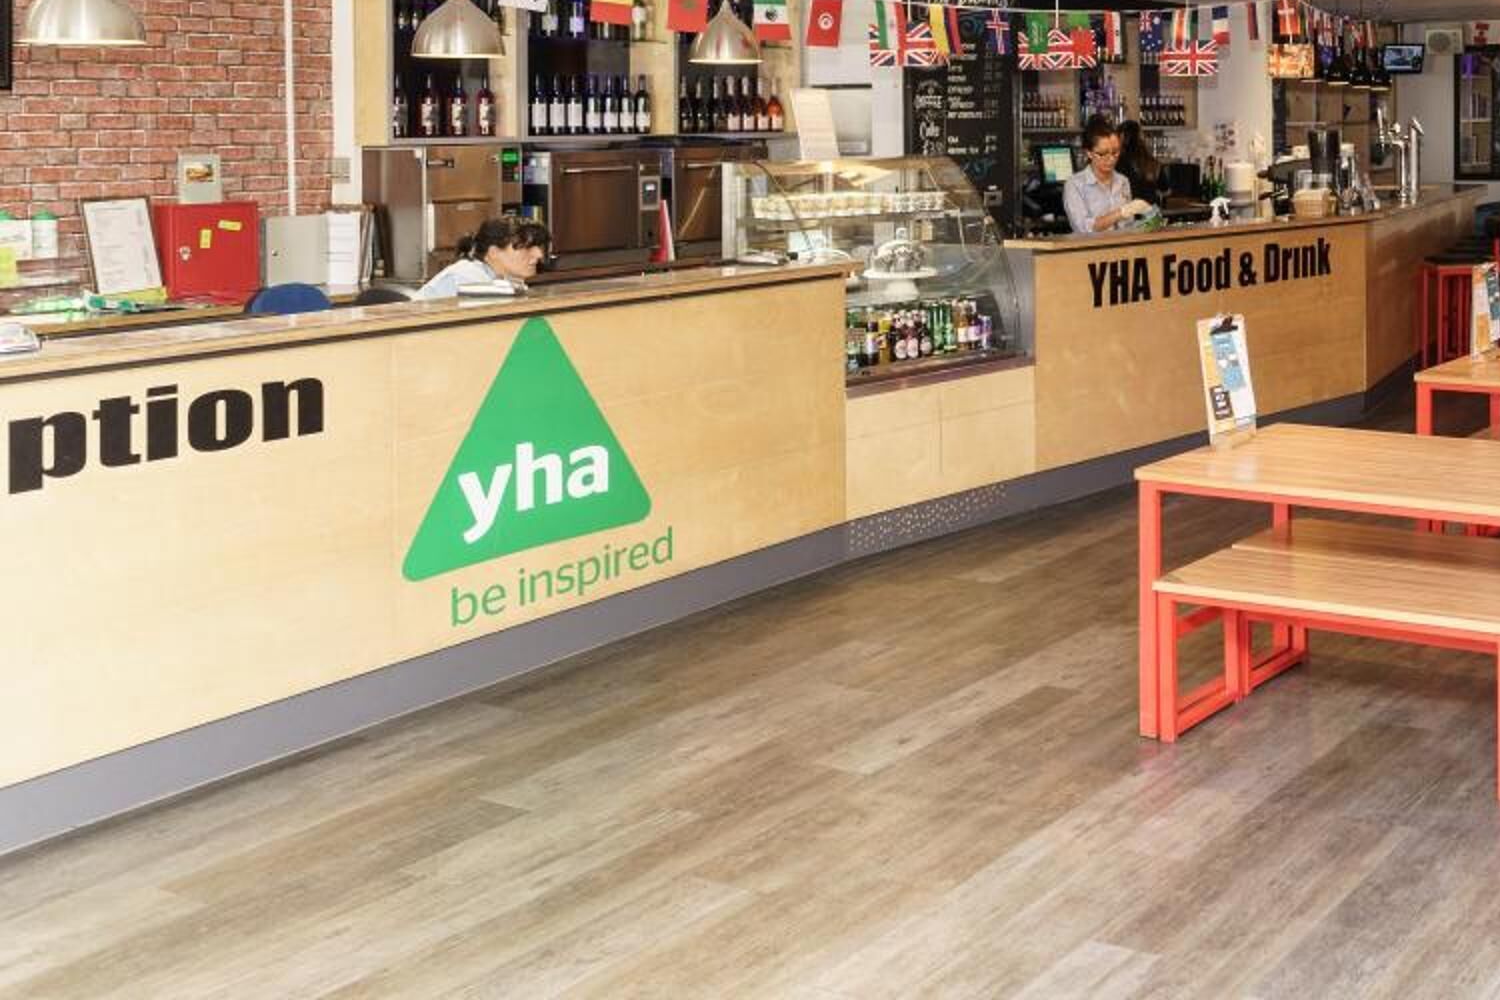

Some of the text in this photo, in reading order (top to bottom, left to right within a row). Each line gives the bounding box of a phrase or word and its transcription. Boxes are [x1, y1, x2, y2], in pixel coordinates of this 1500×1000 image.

[1088, 237, 1332, 308] YHA Food & Drink
[8, 376, 324, 494] ption
[457, 441, 609, 544] yha
[451, 526, 674, 627] be inspired
